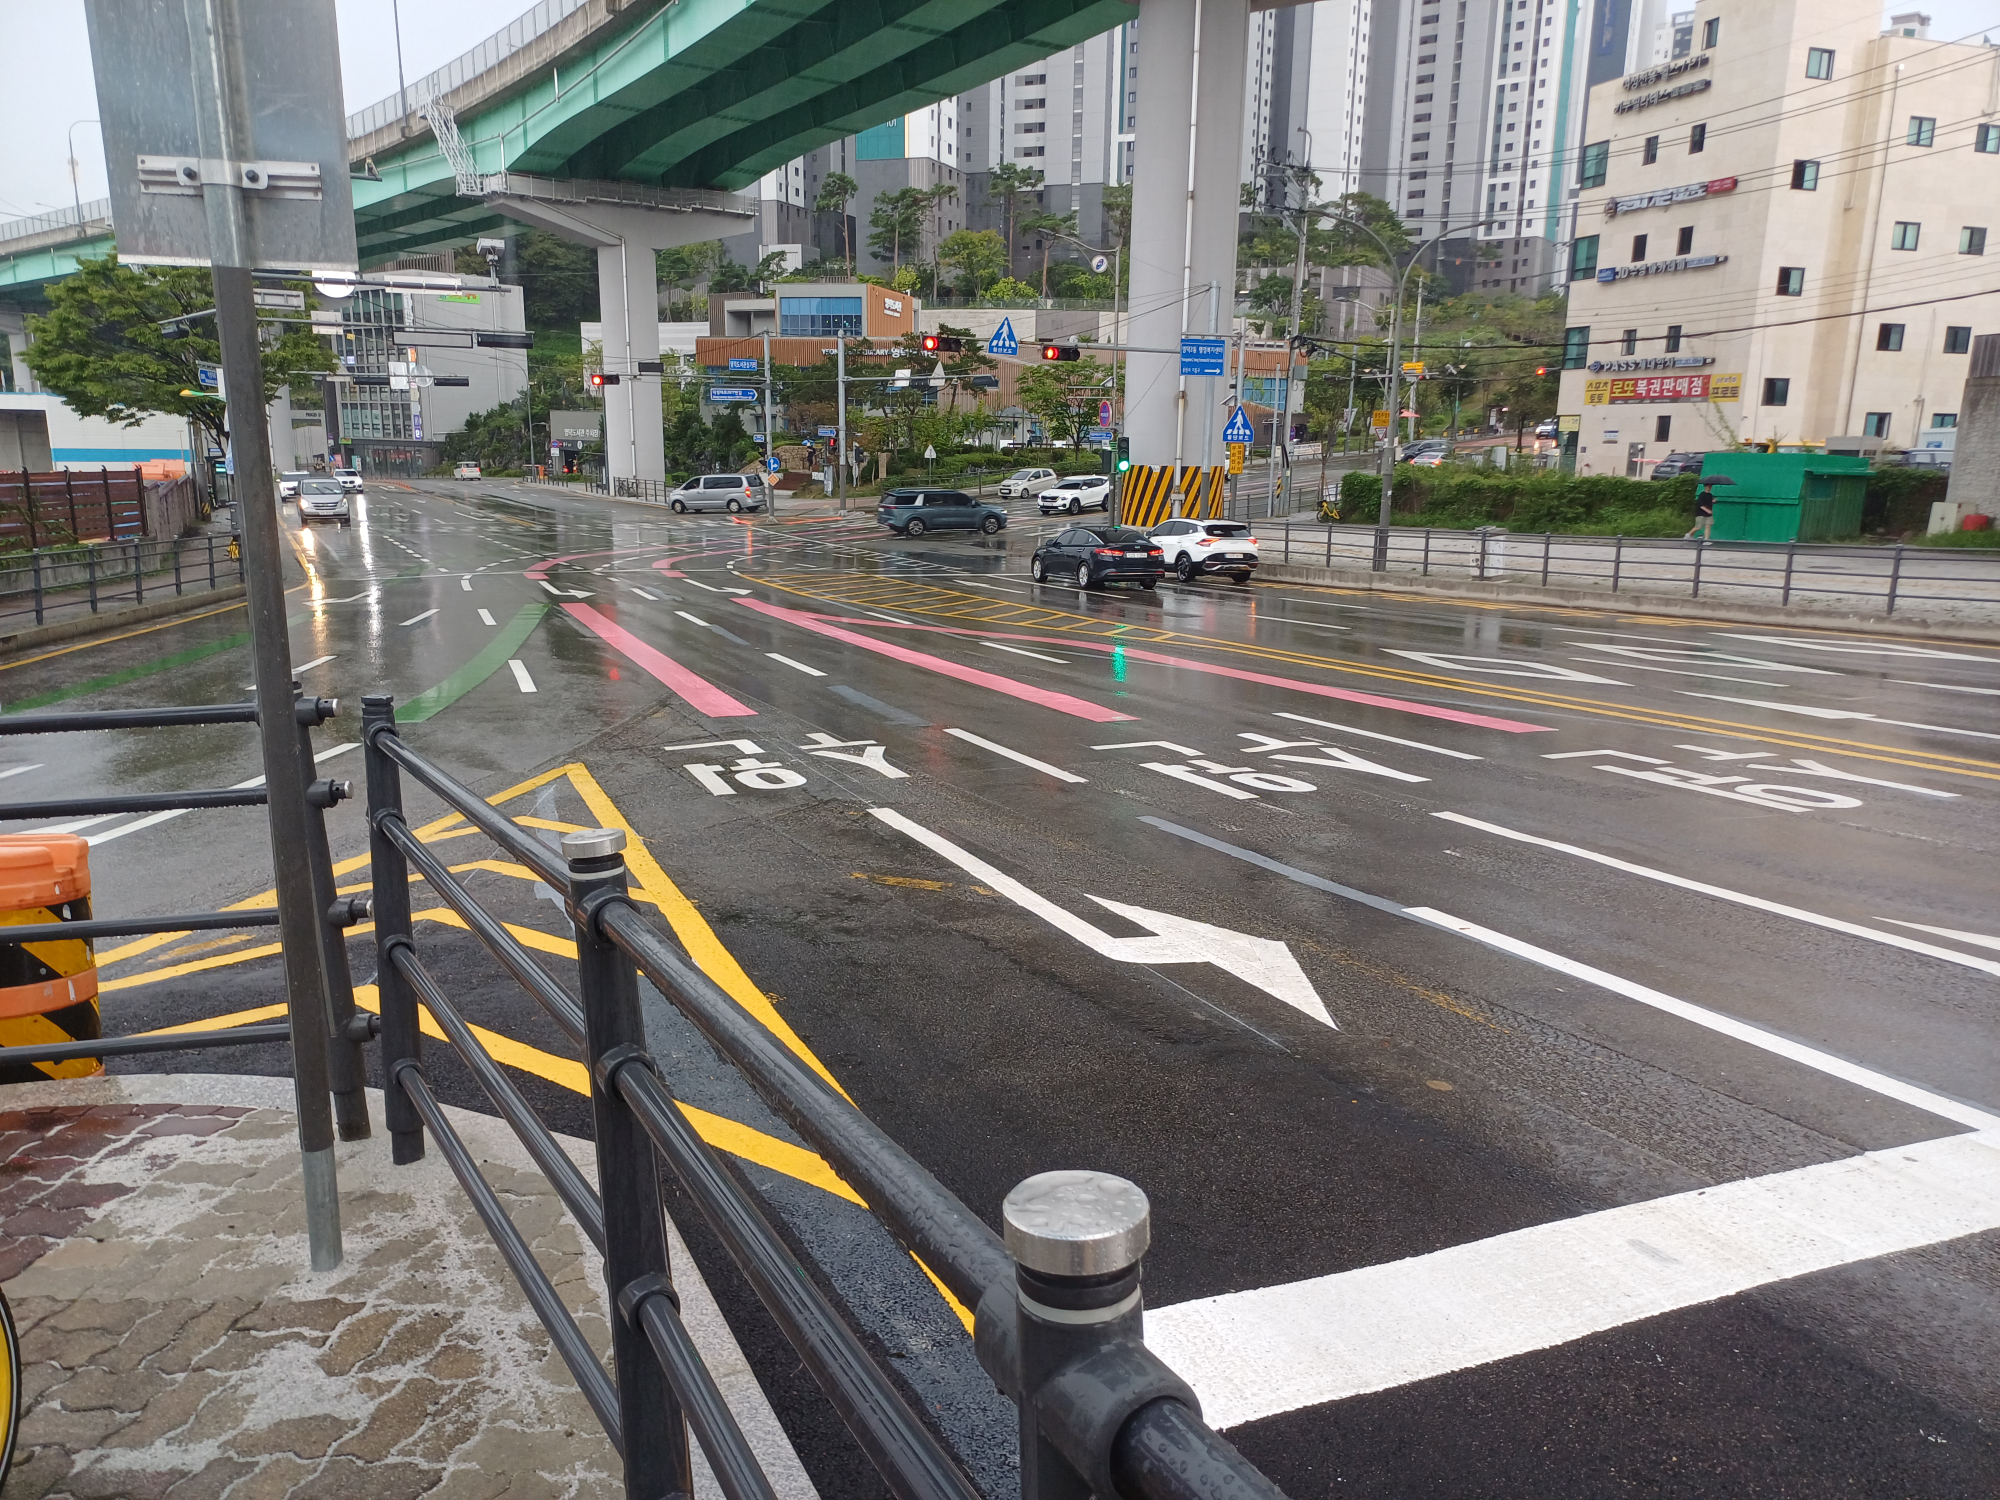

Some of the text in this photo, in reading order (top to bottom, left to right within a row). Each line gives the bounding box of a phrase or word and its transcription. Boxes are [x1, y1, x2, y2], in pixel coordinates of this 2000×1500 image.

[1716, 375, 1737, 385] proto
[1586, 380, 1609, 391] 스포츠
[1711, 385, 1740, 399] 프로토
[1589, 393, 1603, 403] 토토
